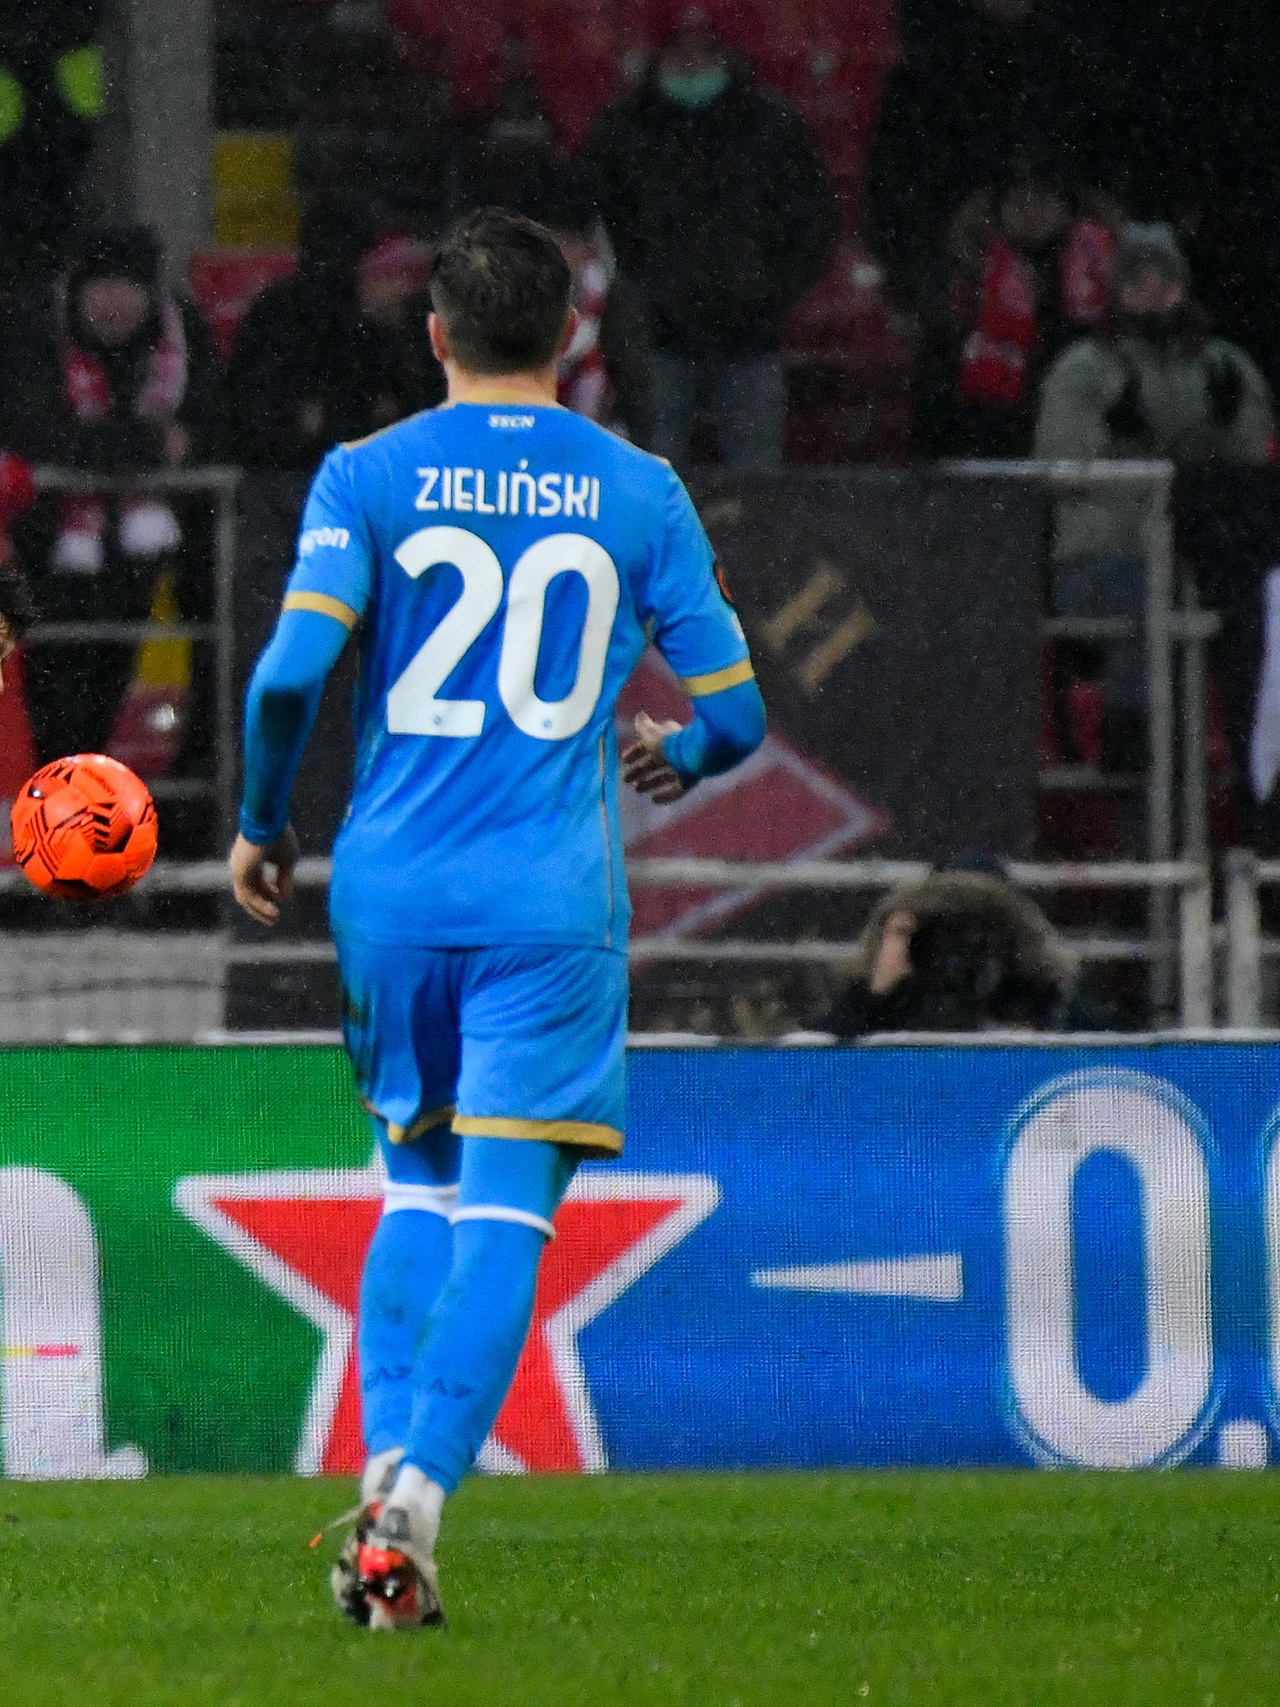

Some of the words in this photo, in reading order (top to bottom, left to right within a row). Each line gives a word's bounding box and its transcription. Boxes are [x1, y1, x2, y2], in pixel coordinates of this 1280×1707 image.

[415, 459, 600, 520] ZIELIŃSKI
[387, 526, 620, 741] 20
[1003, 1085, 1280, 1471] 0.
